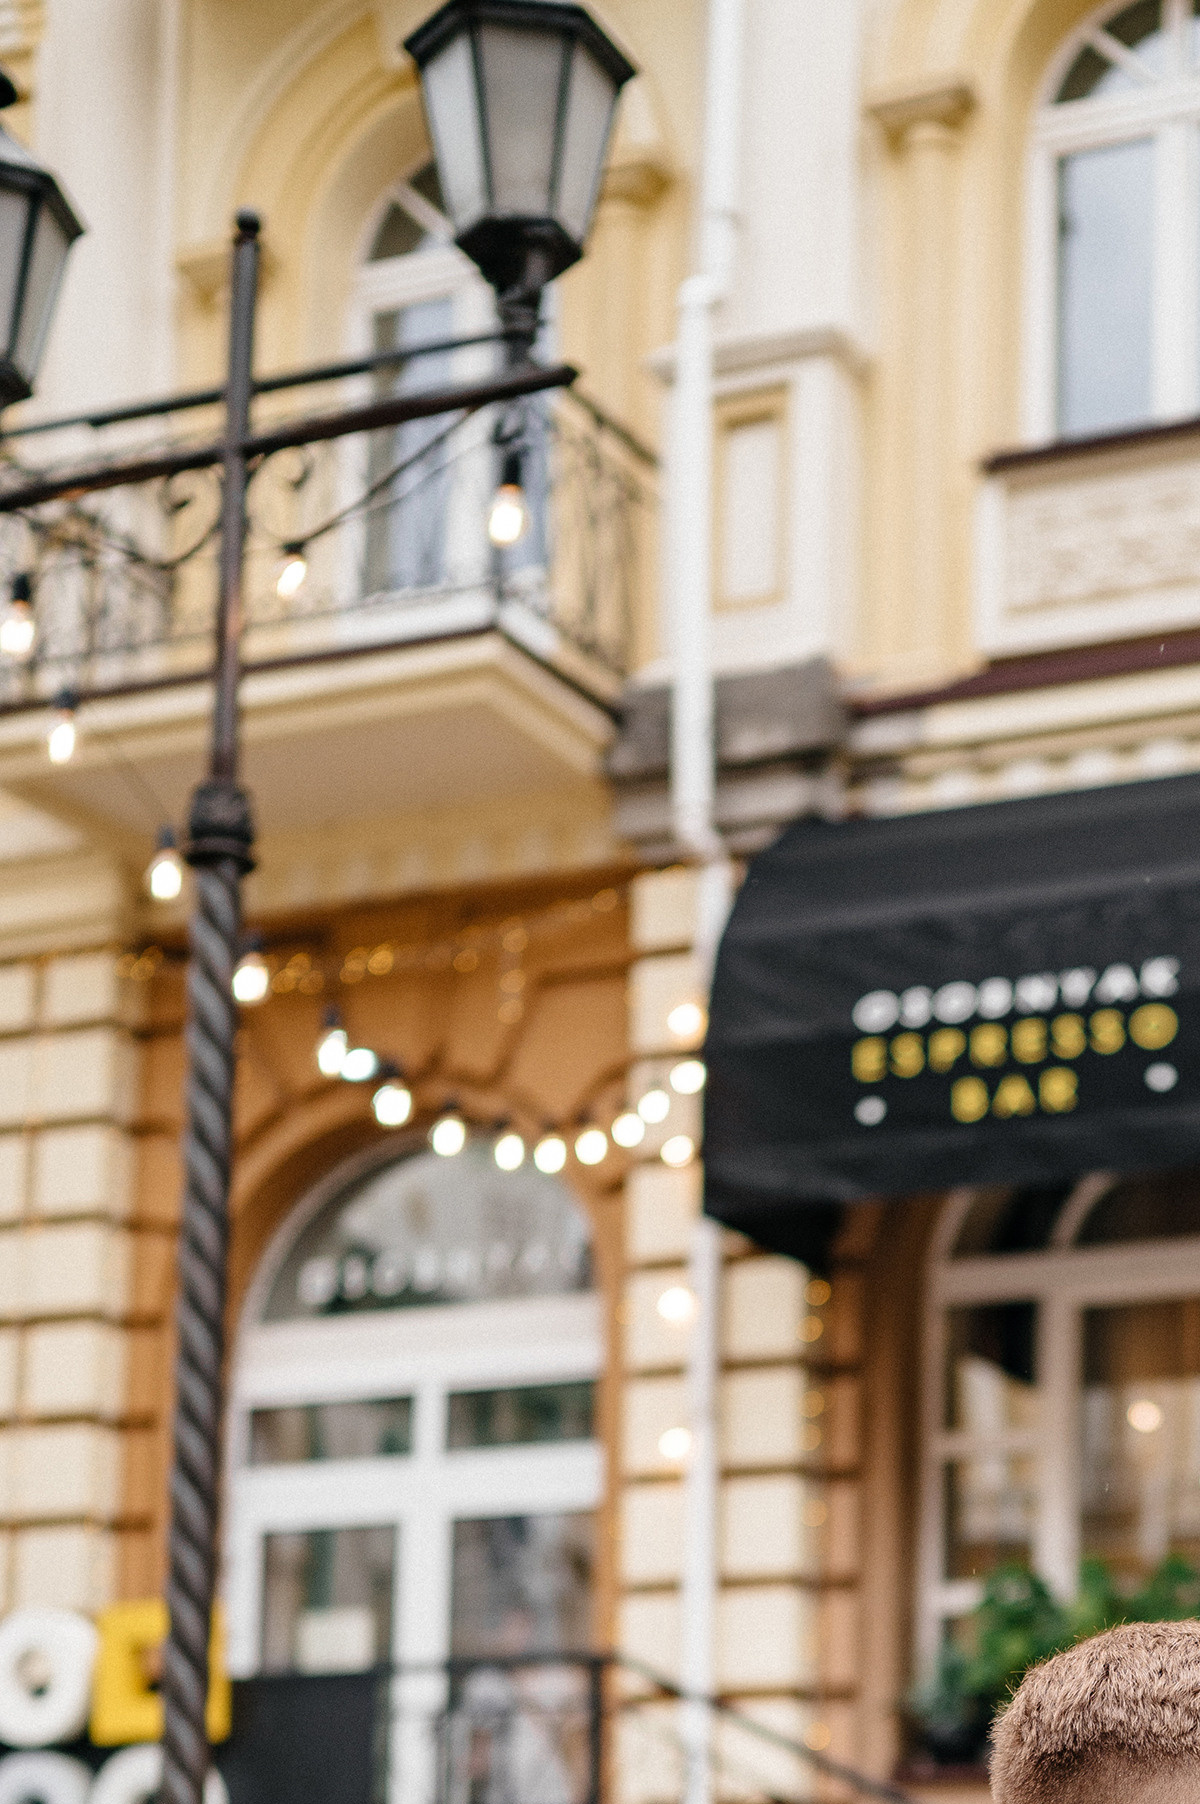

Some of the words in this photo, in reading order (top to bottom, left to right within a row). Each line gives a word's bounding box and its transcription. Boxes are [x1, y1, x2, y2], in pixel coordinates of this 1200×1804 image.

[852, 955, 1180, 1033] OSOBNYAK
[851, 1002, 1179, 1083] ESPRESSO
[950, 1066, 1079, 1123] BAR
